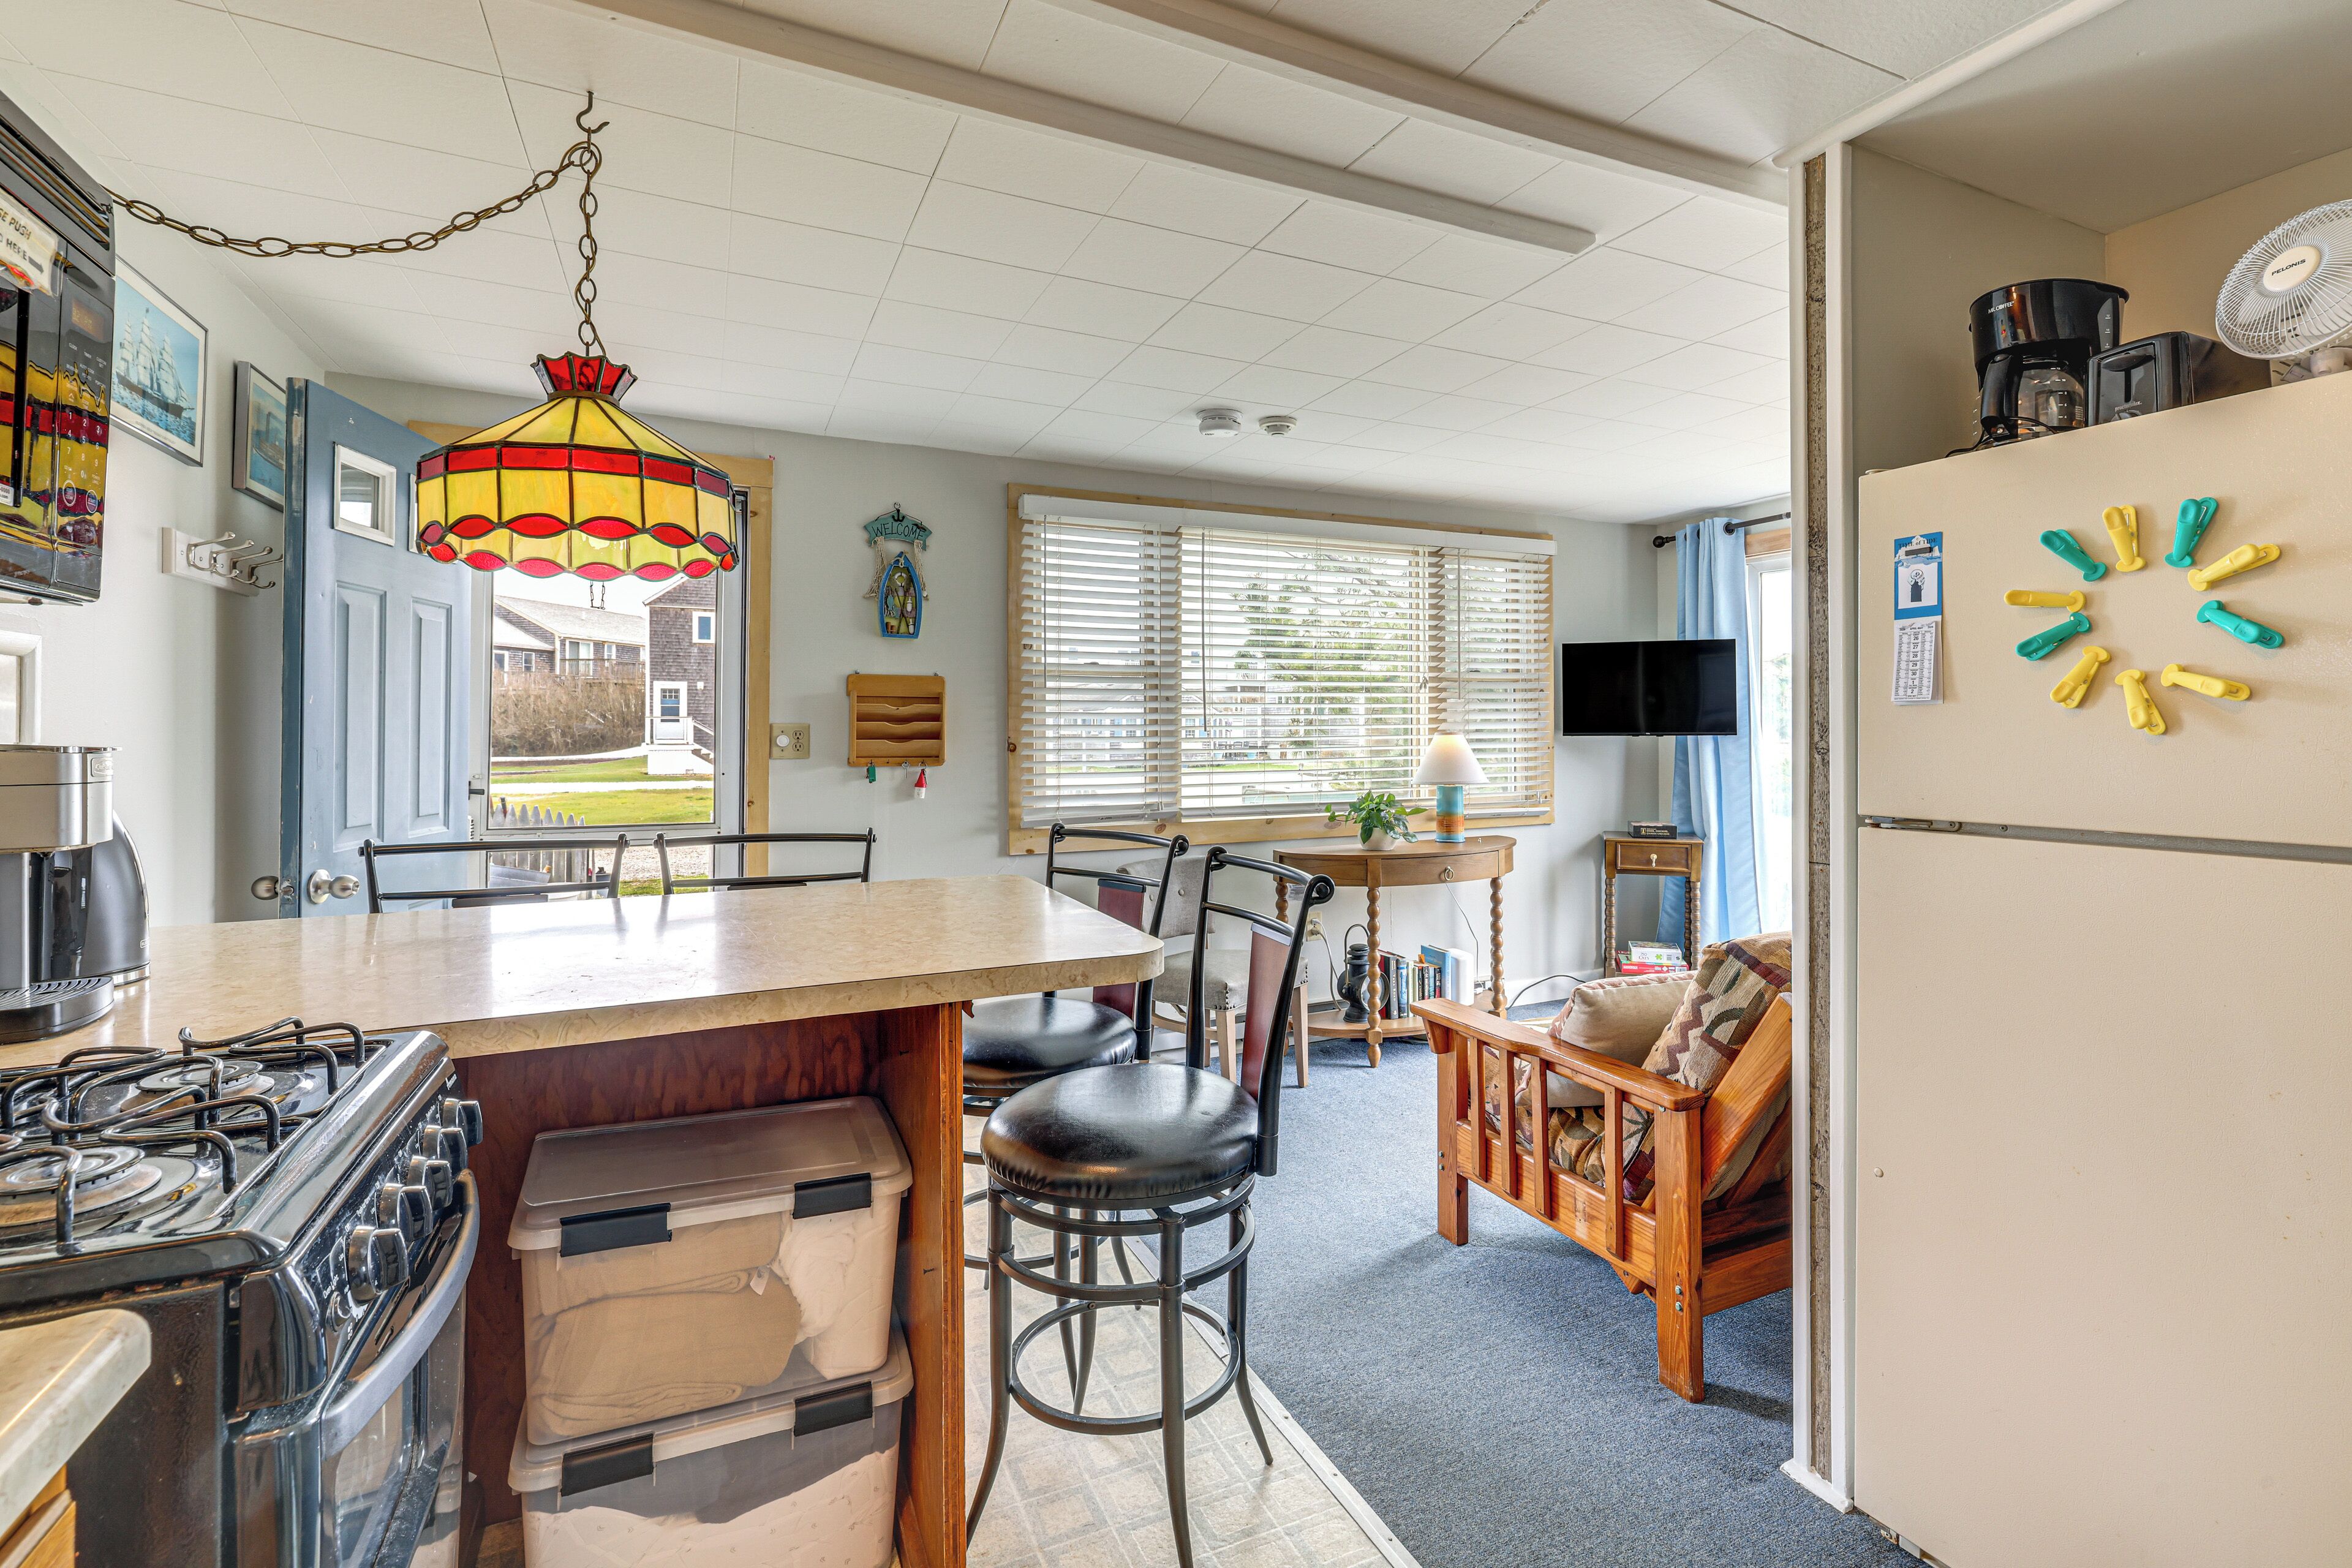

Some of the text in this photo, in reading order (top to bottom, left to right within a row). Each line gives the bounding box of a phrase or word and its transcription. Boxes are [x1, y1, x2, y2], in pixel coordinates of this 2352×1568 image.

[9, 217, 31, 240] PUSH
[6, 238, 28, 261] HERE
[2272, 258, 2306, 276] PELONIS
[1996, 301, 2013, 311] COFFEE
[96, 425, 100, 434] 3
[82, 435, 86, 444] 5
[67, 446, 71, 454] 7
[96, 442, 100, 450] 6
[80, 470, 85, 478] 0
[872, 522, 925, 540] WELCOME
[323, 1287, 332, 1299] Oven
